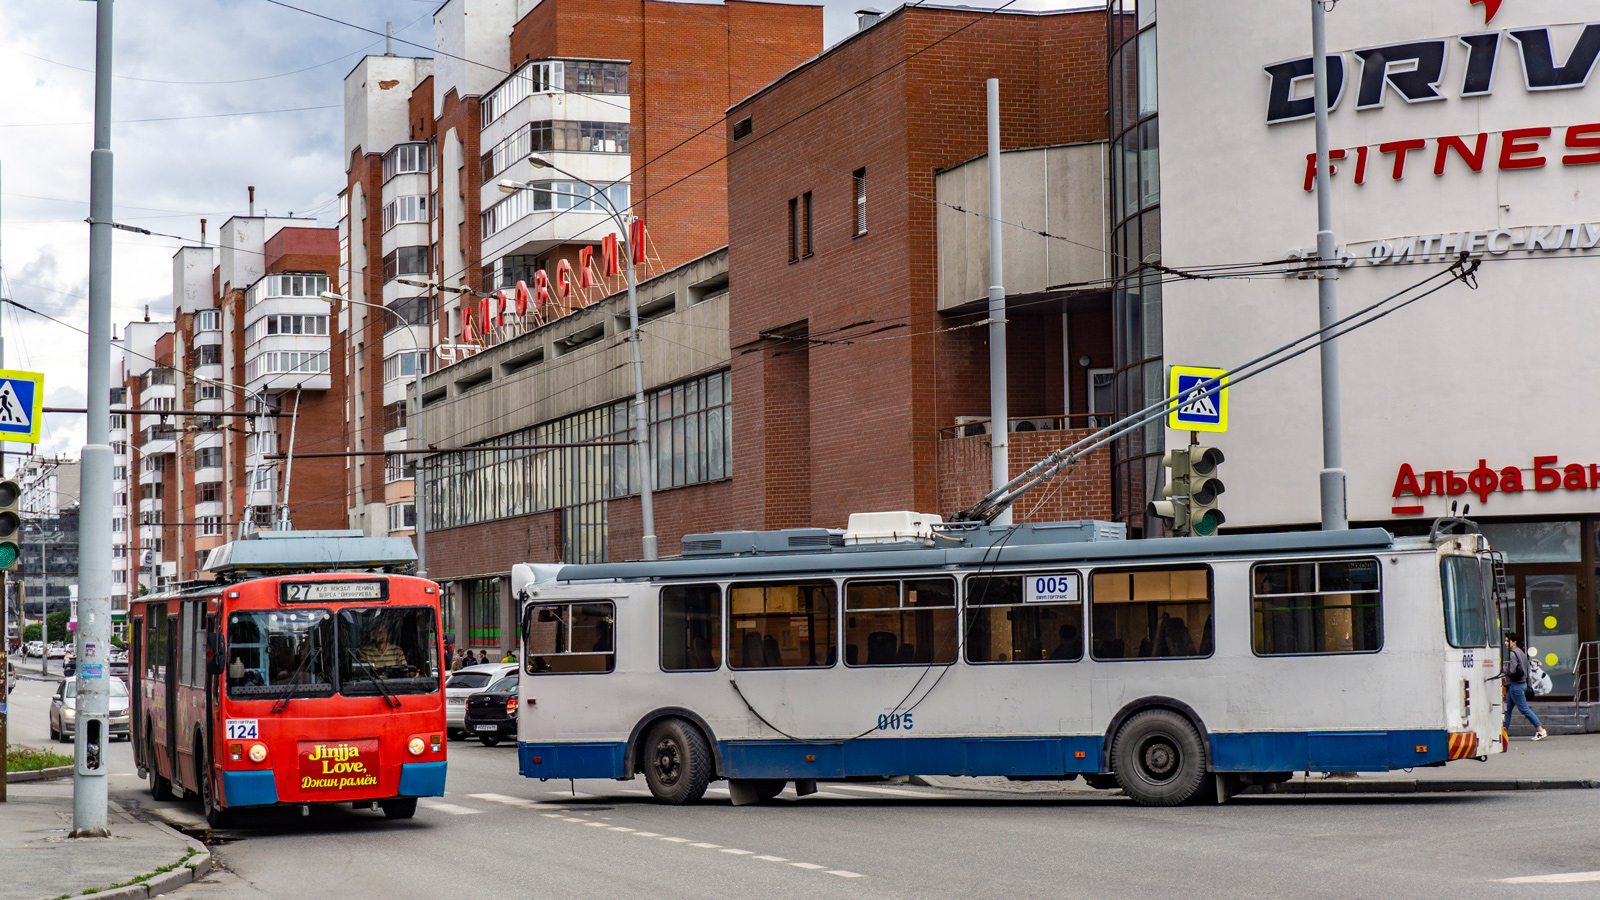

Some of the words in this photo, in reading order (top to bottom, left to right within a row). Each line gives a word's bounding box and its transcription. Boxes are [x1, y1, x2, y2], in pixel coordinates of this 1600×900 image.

[1262, 22, 1600, 126] DRIV
[1303, 123, 1600, 191] FITNES
[1281, 245, 1356, 275] СЕЬ
[1392, 459, 1524, 503] Альфа
[290, 584, 312, 600] 27
[1036, 577, 1068, 593] 005
[1462, 654, 1474, 668] 005
[878, 714, 913, 730] 005
[228, 725, 257, 739] 124
[308, 744, 360, 762] Jinjja
[322, 760, 367, 774] Love,
[301, 775, 339, 789] Джин
[339, 774, 377, 790] рамён
